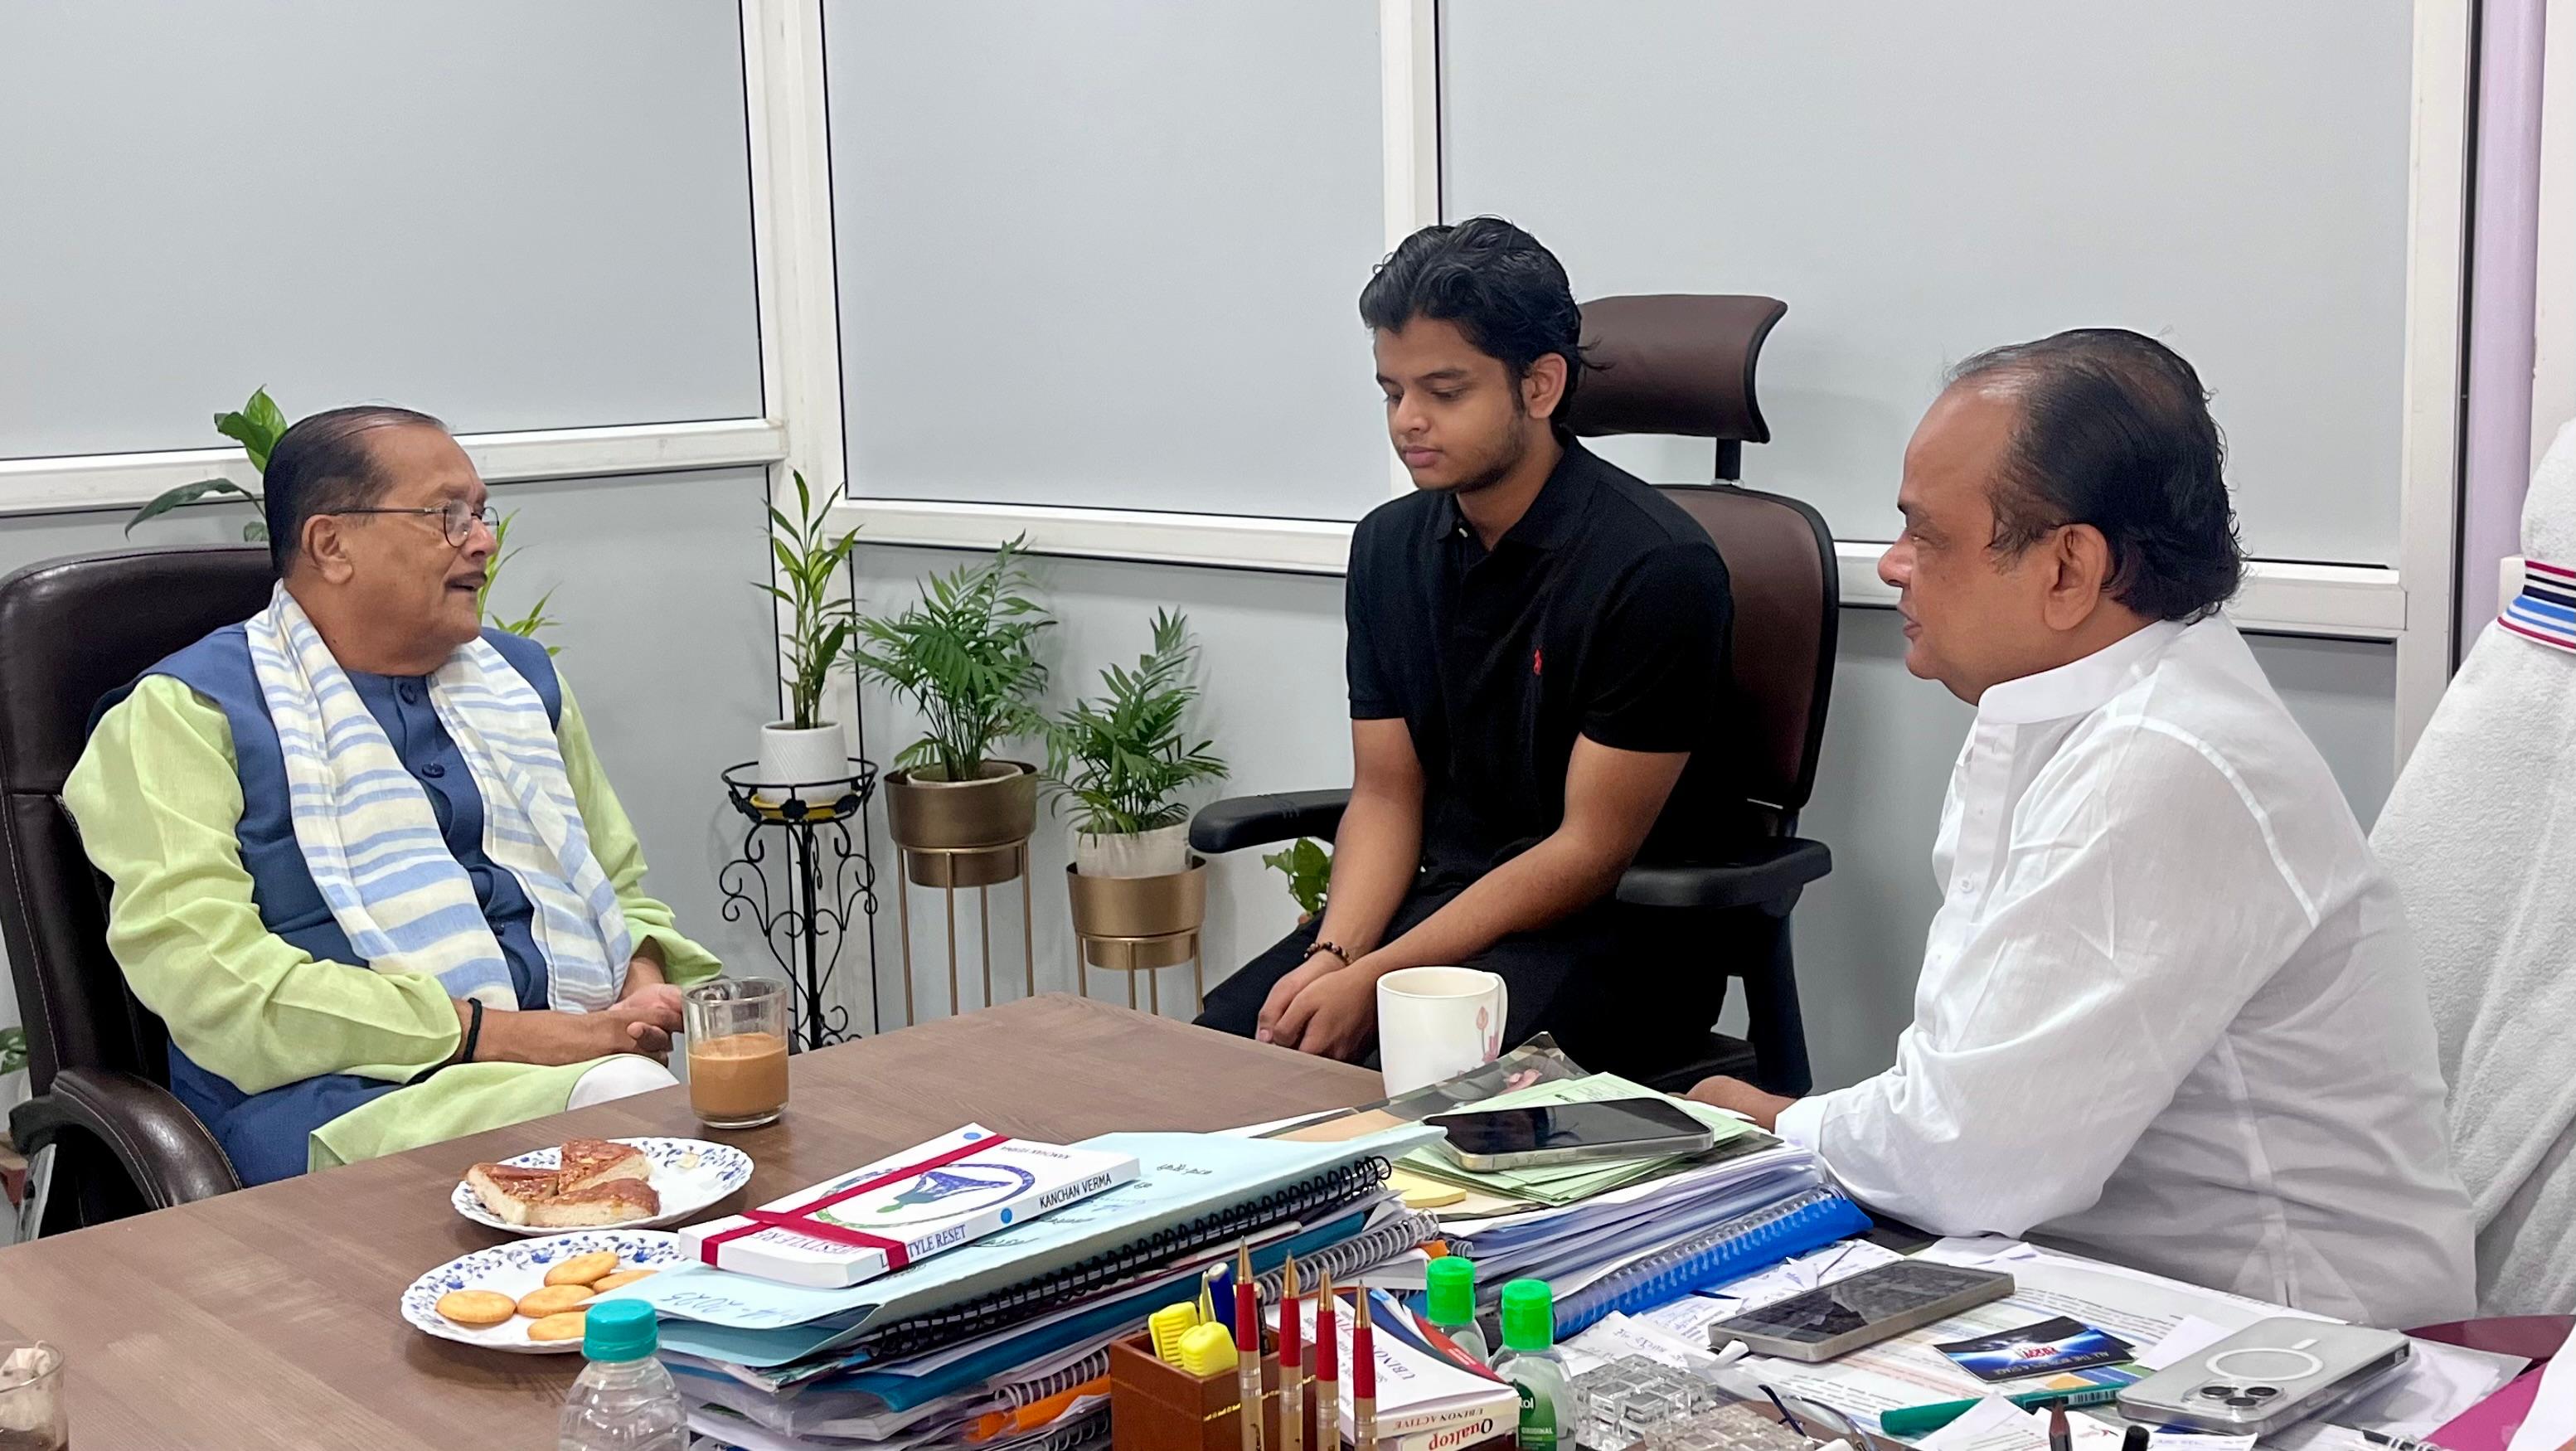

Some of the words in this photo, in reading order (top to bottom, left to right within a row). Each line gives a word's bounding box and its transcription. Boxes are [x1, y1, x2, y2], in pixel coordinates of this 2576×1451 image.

[1039, 1183, 1080, 1209] KANCHAN
[1082, 1172, 1112, 1193] VERMA
[936, 1224, 966, 1251] RESET
[1374, 1344, 1416, 1380] UBINO
[1395, 1415, 1438, 1431] ACTIVE
[1439, 1408, 1484, 1422] UBINON
